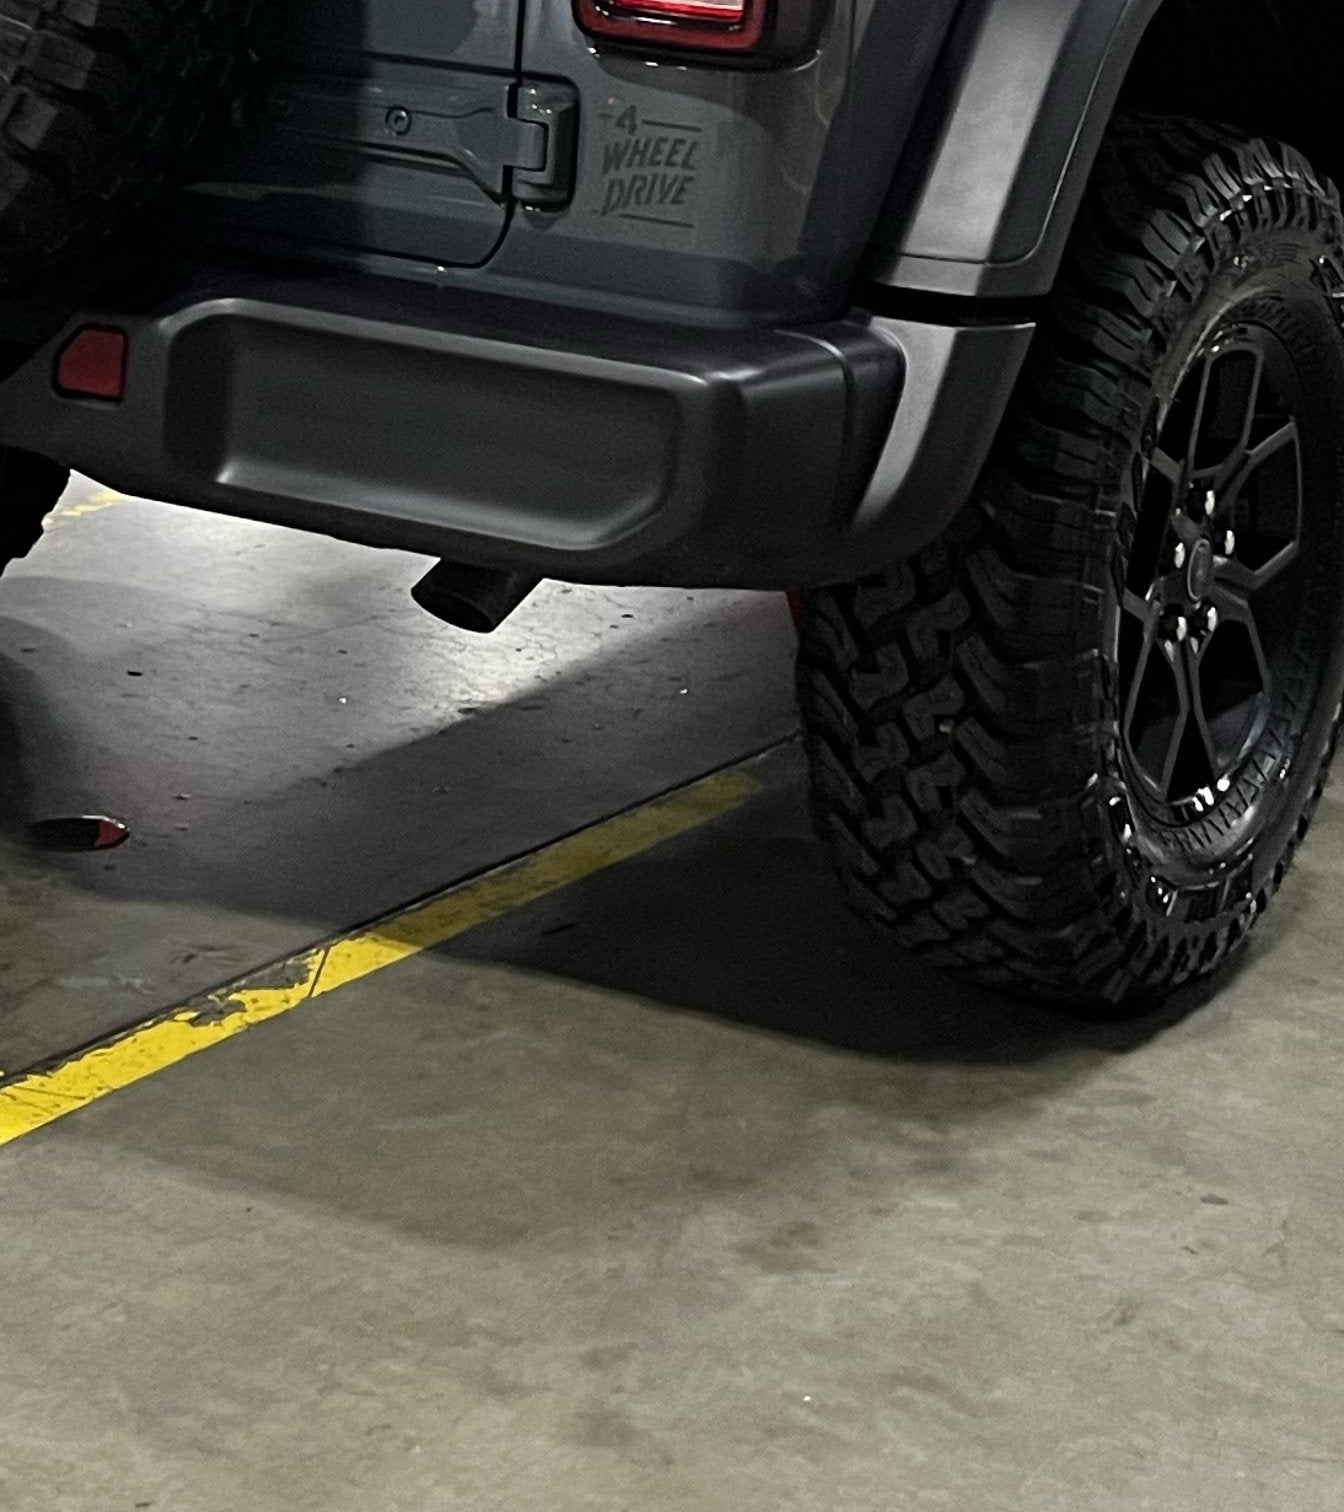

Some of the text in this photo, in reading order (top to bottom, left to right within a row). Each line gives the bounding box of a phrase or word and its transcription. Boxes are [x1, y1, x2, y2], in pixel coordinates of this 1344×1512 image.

[614, 104, 638, 135] 4
[602, 137, 699, 175] WHEEL
[601, 172, 695, 216] DRIVE
